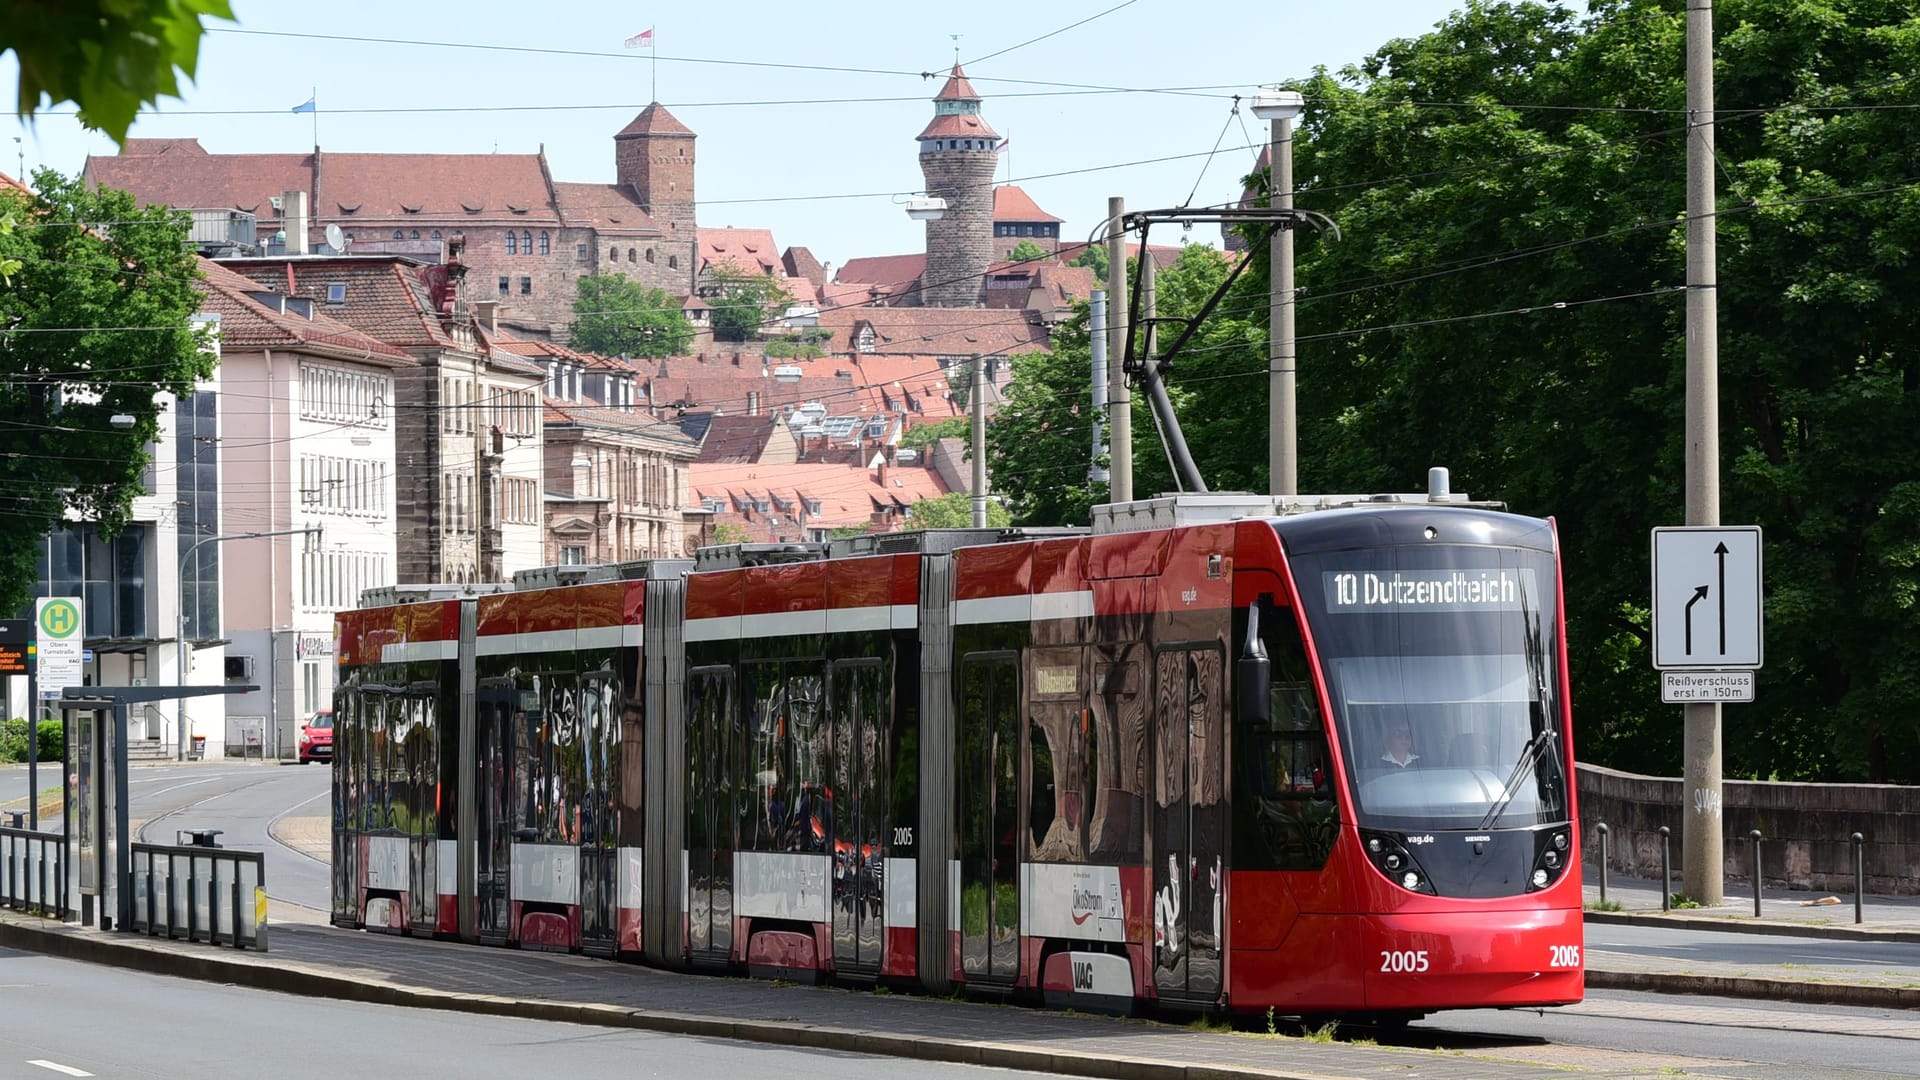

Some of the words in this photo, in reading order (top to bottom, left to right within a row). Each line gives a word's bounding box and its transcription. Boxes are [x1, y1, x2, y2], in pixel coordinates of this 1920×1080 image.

[1334, 573, 1357, 605] 10
[1364, 571, 1514, 605] Dutzendteich
[50, 608, 68, 629] H
[1667, 676, 1750, 687] Reißverschluss
[1673, 688, 1695, 698] erst
[1699, 687, 1709, 697] in
[893, 827, 913, 846] 2005
[1407, 834, 1434, 845] vag.de
[1465, 835, 1491, 843] SIEMENS
[1072, 884, 1103, 911] ÖkoStrom
[1380, 950, 1430, 973] 2005
[1550, 945, 1580, 967] 2005
[1074, 961, 1093, 990] VAG
